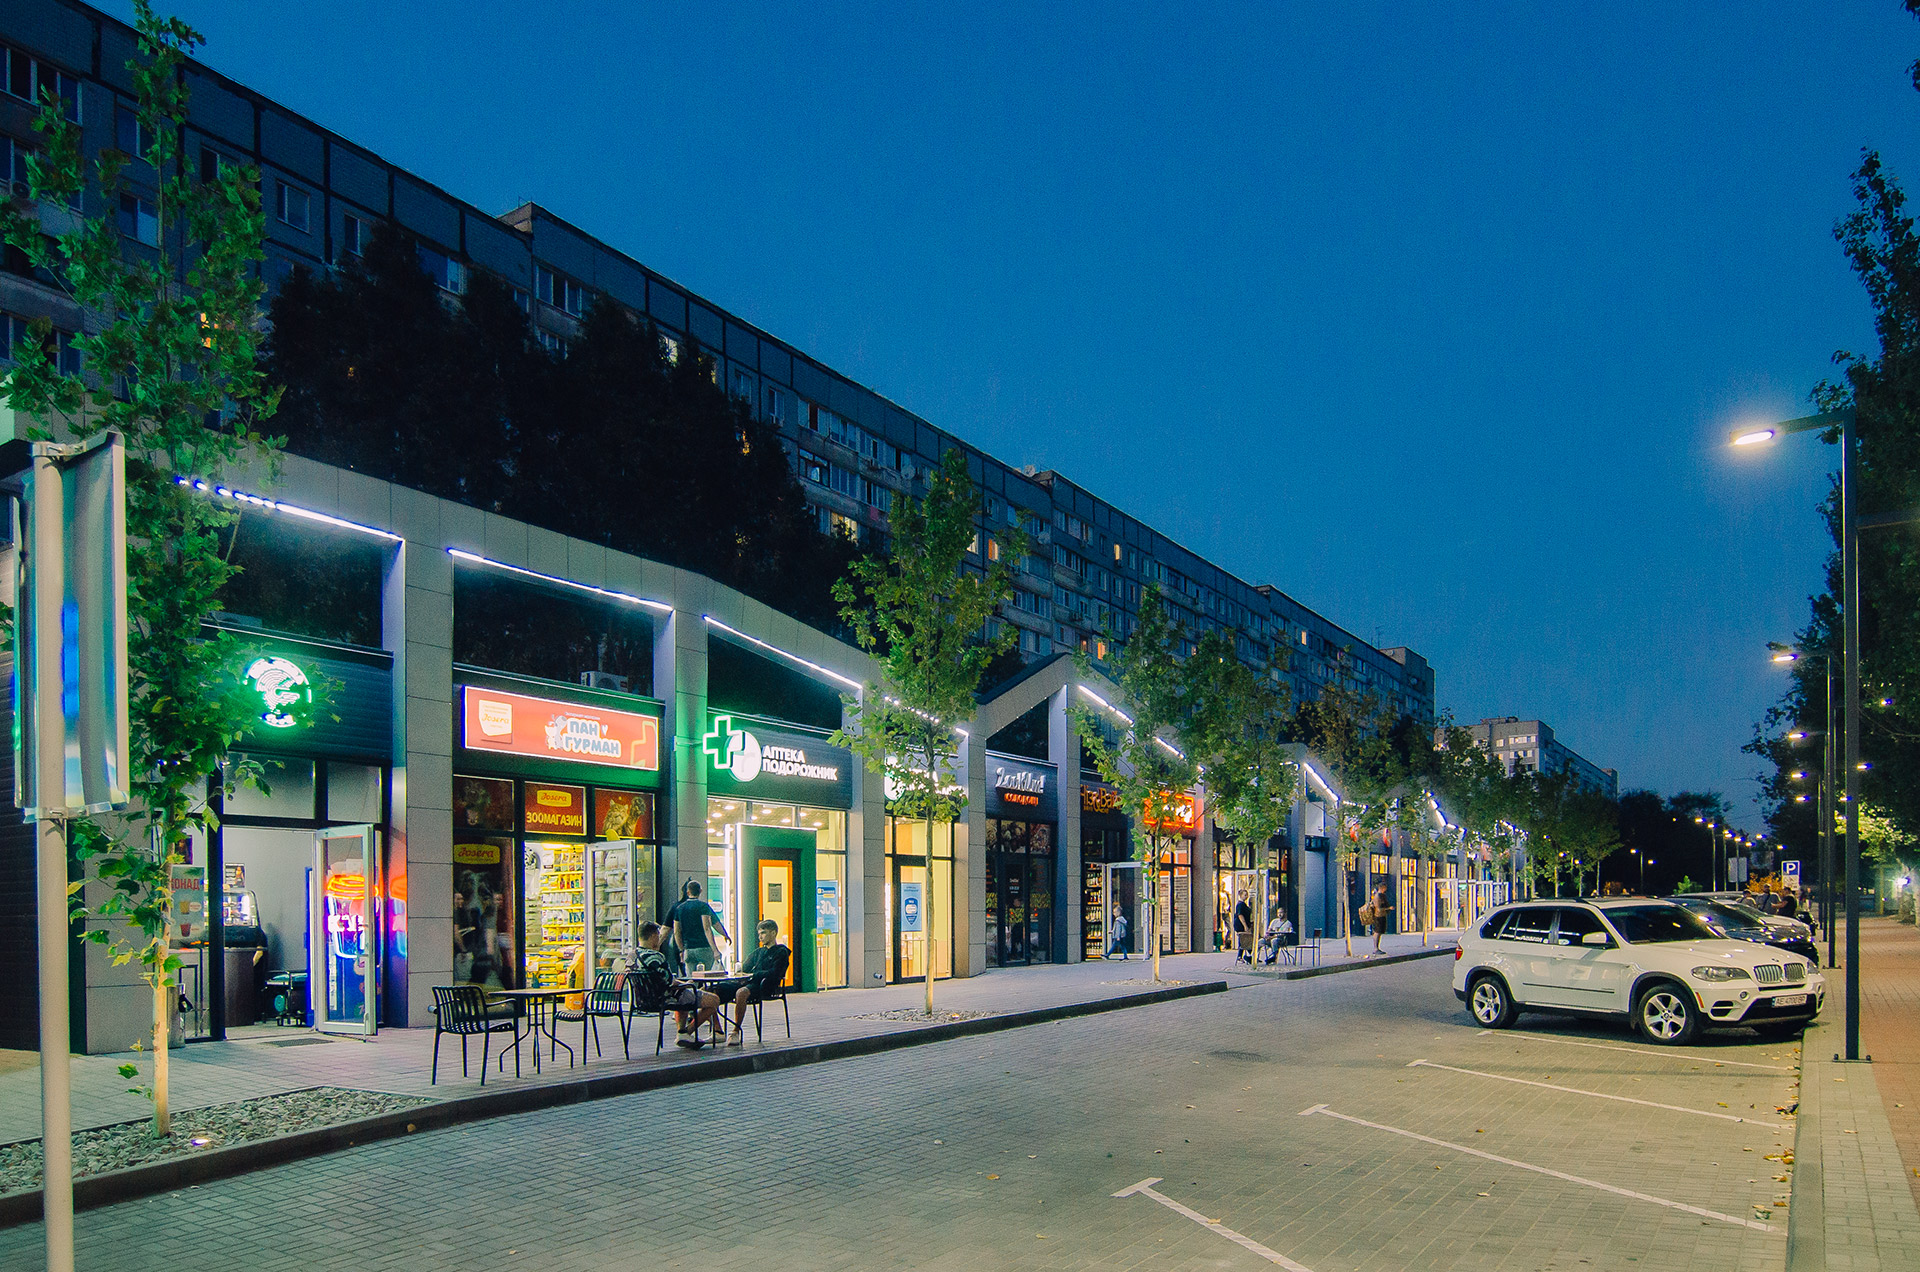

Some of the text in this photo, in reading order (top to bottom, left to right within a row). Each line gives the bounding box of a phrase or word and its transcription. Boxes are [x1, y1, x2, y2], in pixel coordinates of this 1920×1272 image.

[569, 720, 598, 736] ПАН
[565, 735, 619, 755] ГУРМАН
[762, 745, 806, 763] АПТЕКА
[761, 758, 838, 781] ПОДОРОЖНИК
[540, 793, 568, 802] Josera
[526, 811, 583, 827] ЗООМАГАЗИН
[458, 846, 494, 858] Josera
[1786, 862, 1797, 875] P
